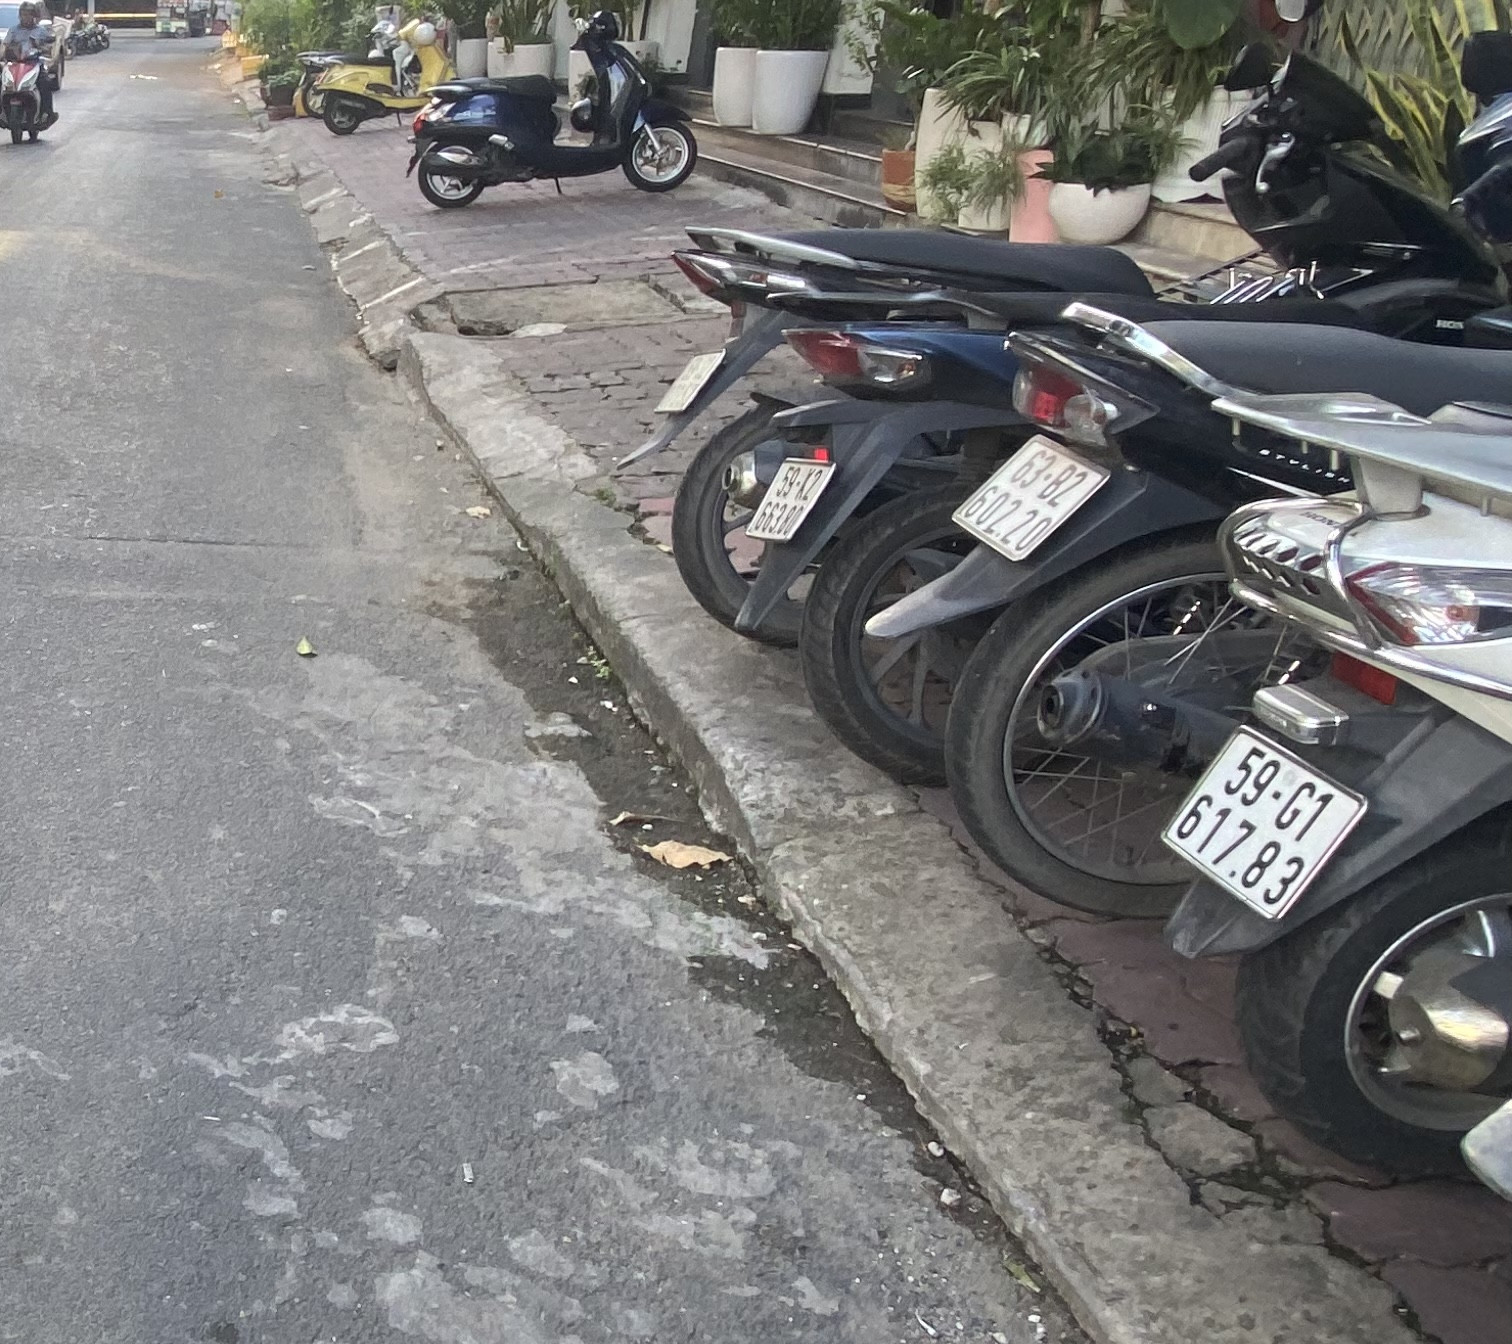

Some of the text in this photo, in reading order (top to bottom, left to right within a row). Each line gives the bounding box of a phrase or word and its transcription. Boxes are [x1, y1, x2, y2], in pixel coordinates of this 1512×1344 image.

[1436, 319, 1464, 329] HON
[964, 486, 1053, 551] 602.20
[1224, 746, 1335, 842] 59-G1
[1176, 794, 1305, 904] 617.83
